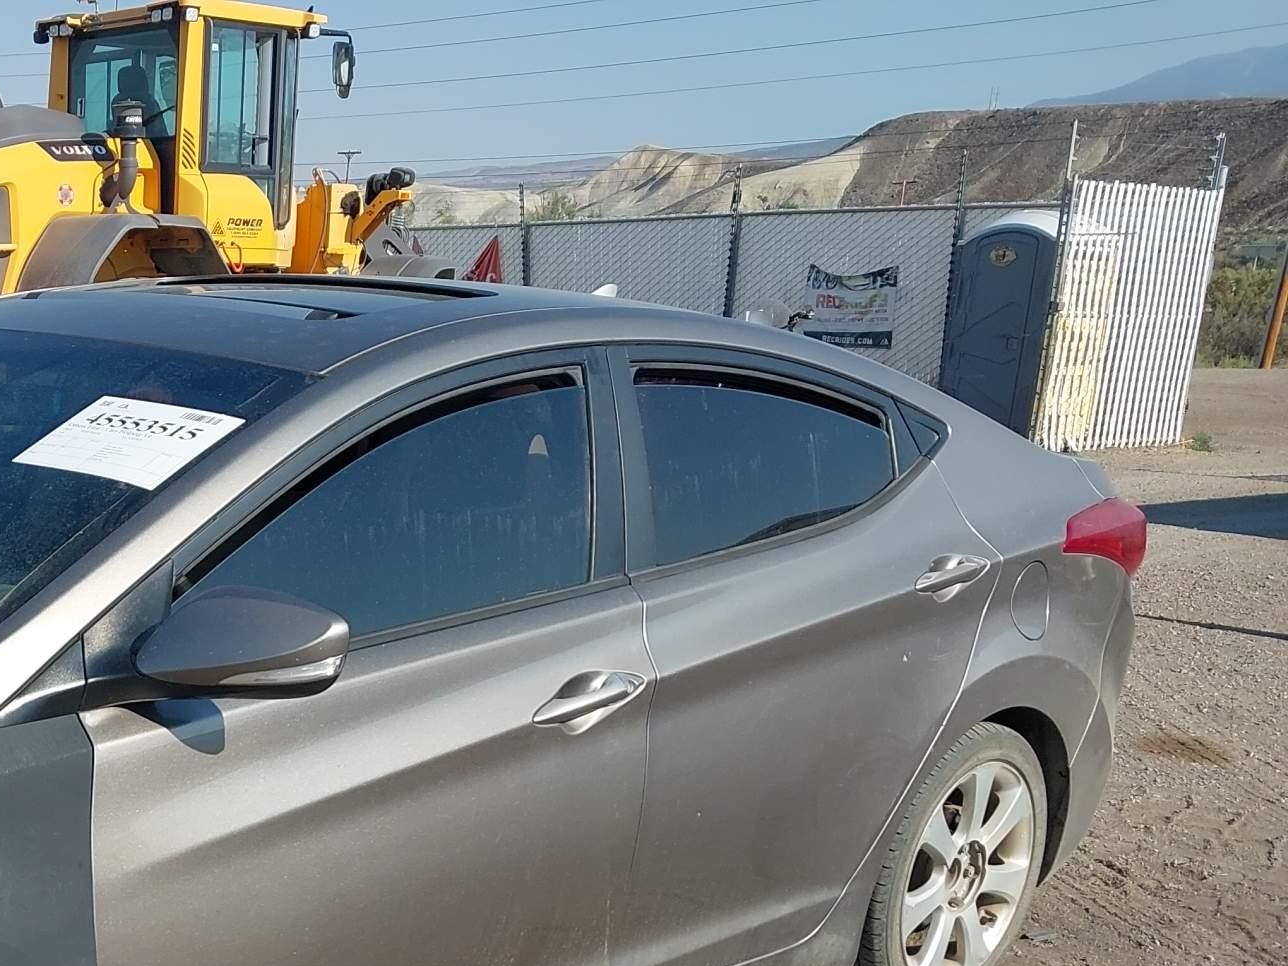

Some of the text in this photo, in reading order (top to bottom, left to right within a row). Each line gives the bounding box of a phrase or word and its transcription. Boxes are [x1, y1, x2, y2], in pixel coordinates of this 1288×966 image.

[50, 145, 107, 156] VOLVO
[227, 217, 264, 228] POWER
[86, 412, 206, 441] 45553515
